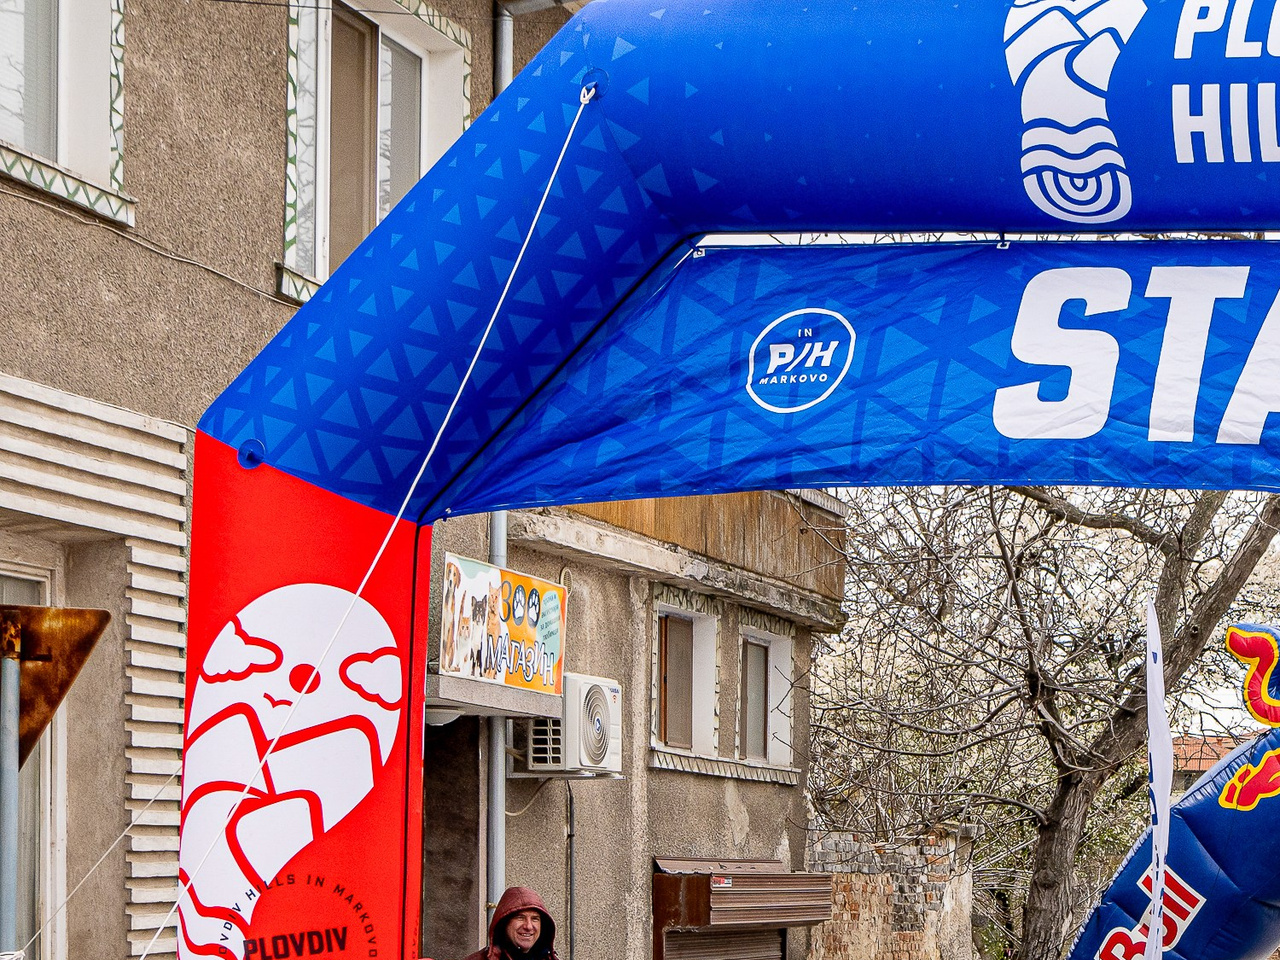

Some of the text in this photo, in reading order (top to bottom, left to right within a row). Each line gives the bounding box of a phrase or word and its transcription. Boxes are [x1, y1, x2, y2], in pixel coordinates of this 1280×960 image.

[797, 327, 813, 338] IN
[766, 340, 840, 375] P/H
[758, 373, 828, 385] MARKOVO
[486, 633, 555, 686] МАГАЗИН
[245, 873, 296, 901] HILLS
[306, 874, 325, 887] IN
[333, 883, 378, 958] MARKOVO
